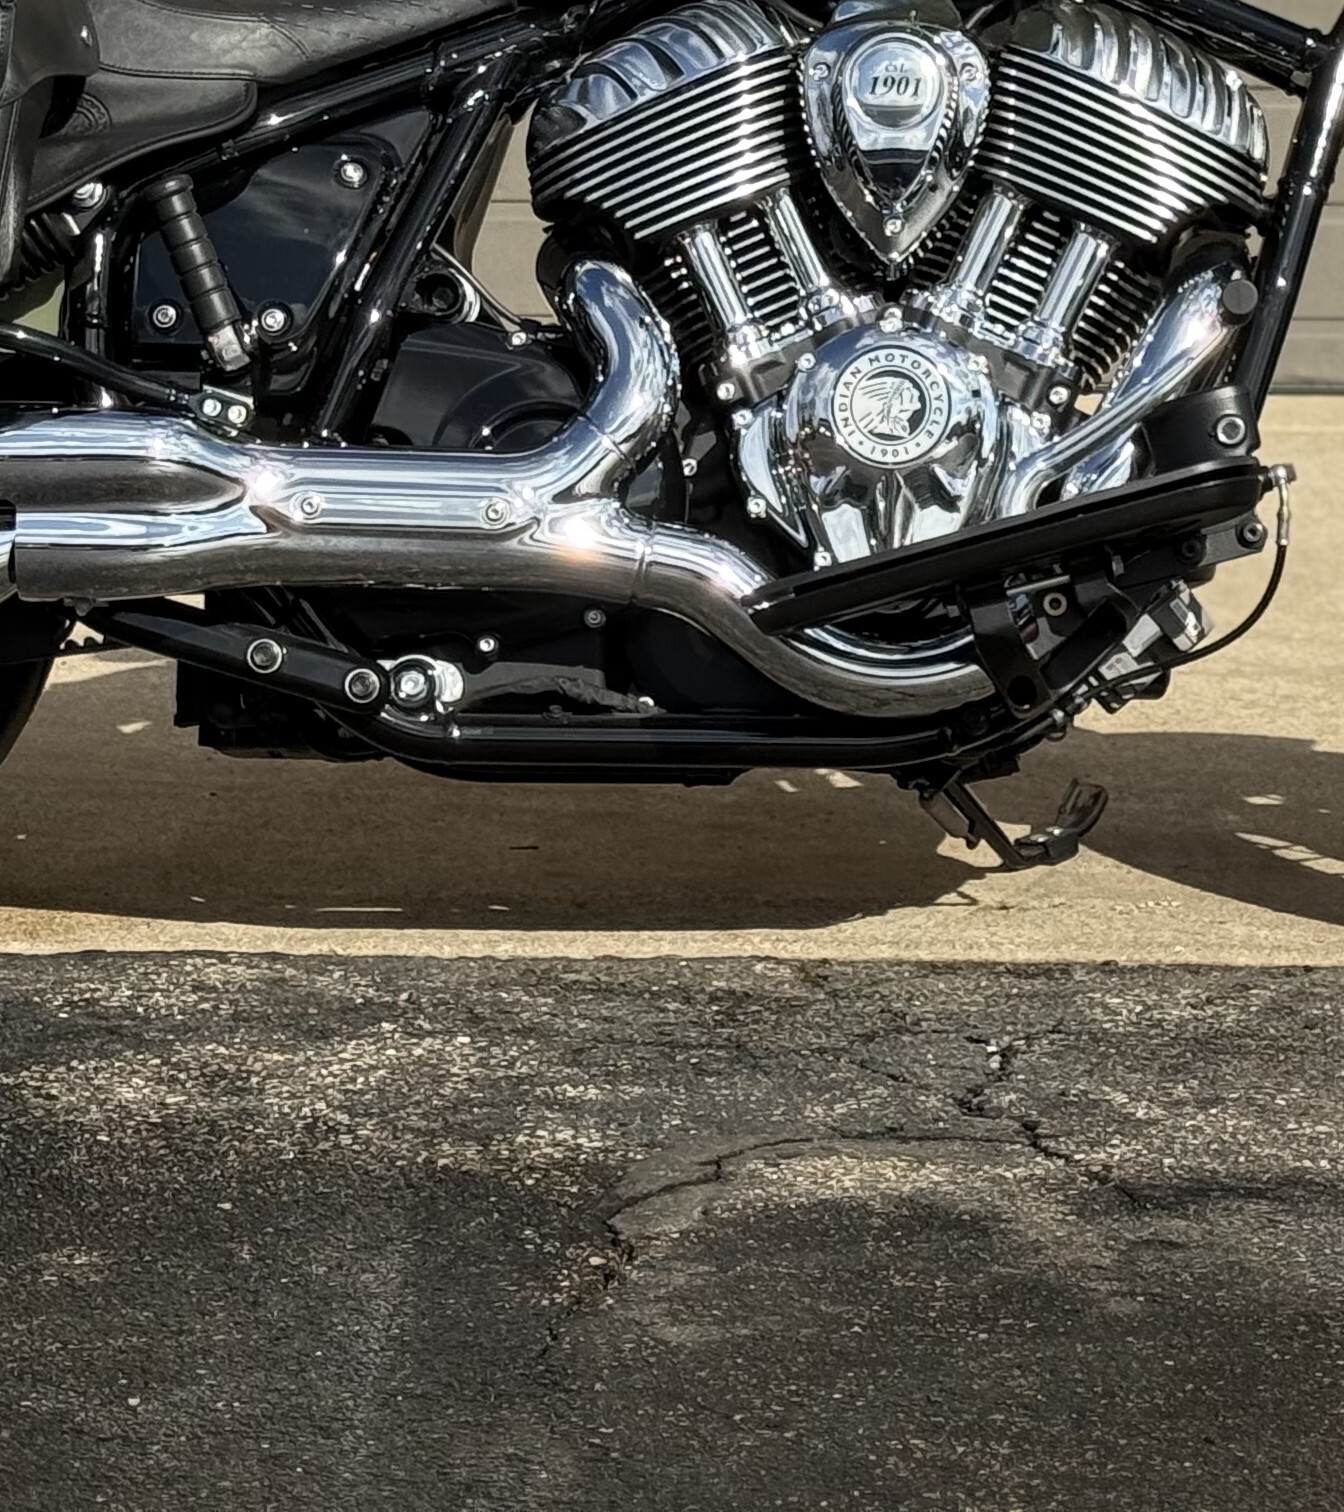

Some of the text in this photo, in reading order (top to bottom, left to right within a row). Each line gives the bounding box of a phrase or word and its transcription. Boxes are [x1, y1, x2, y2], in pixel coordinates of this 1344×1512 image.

[869, 75, 923, 97] 1901
[838, 353, 944, 439] INDIAN MOTORCYCLE
[870, 446, 910, 458] 1901
